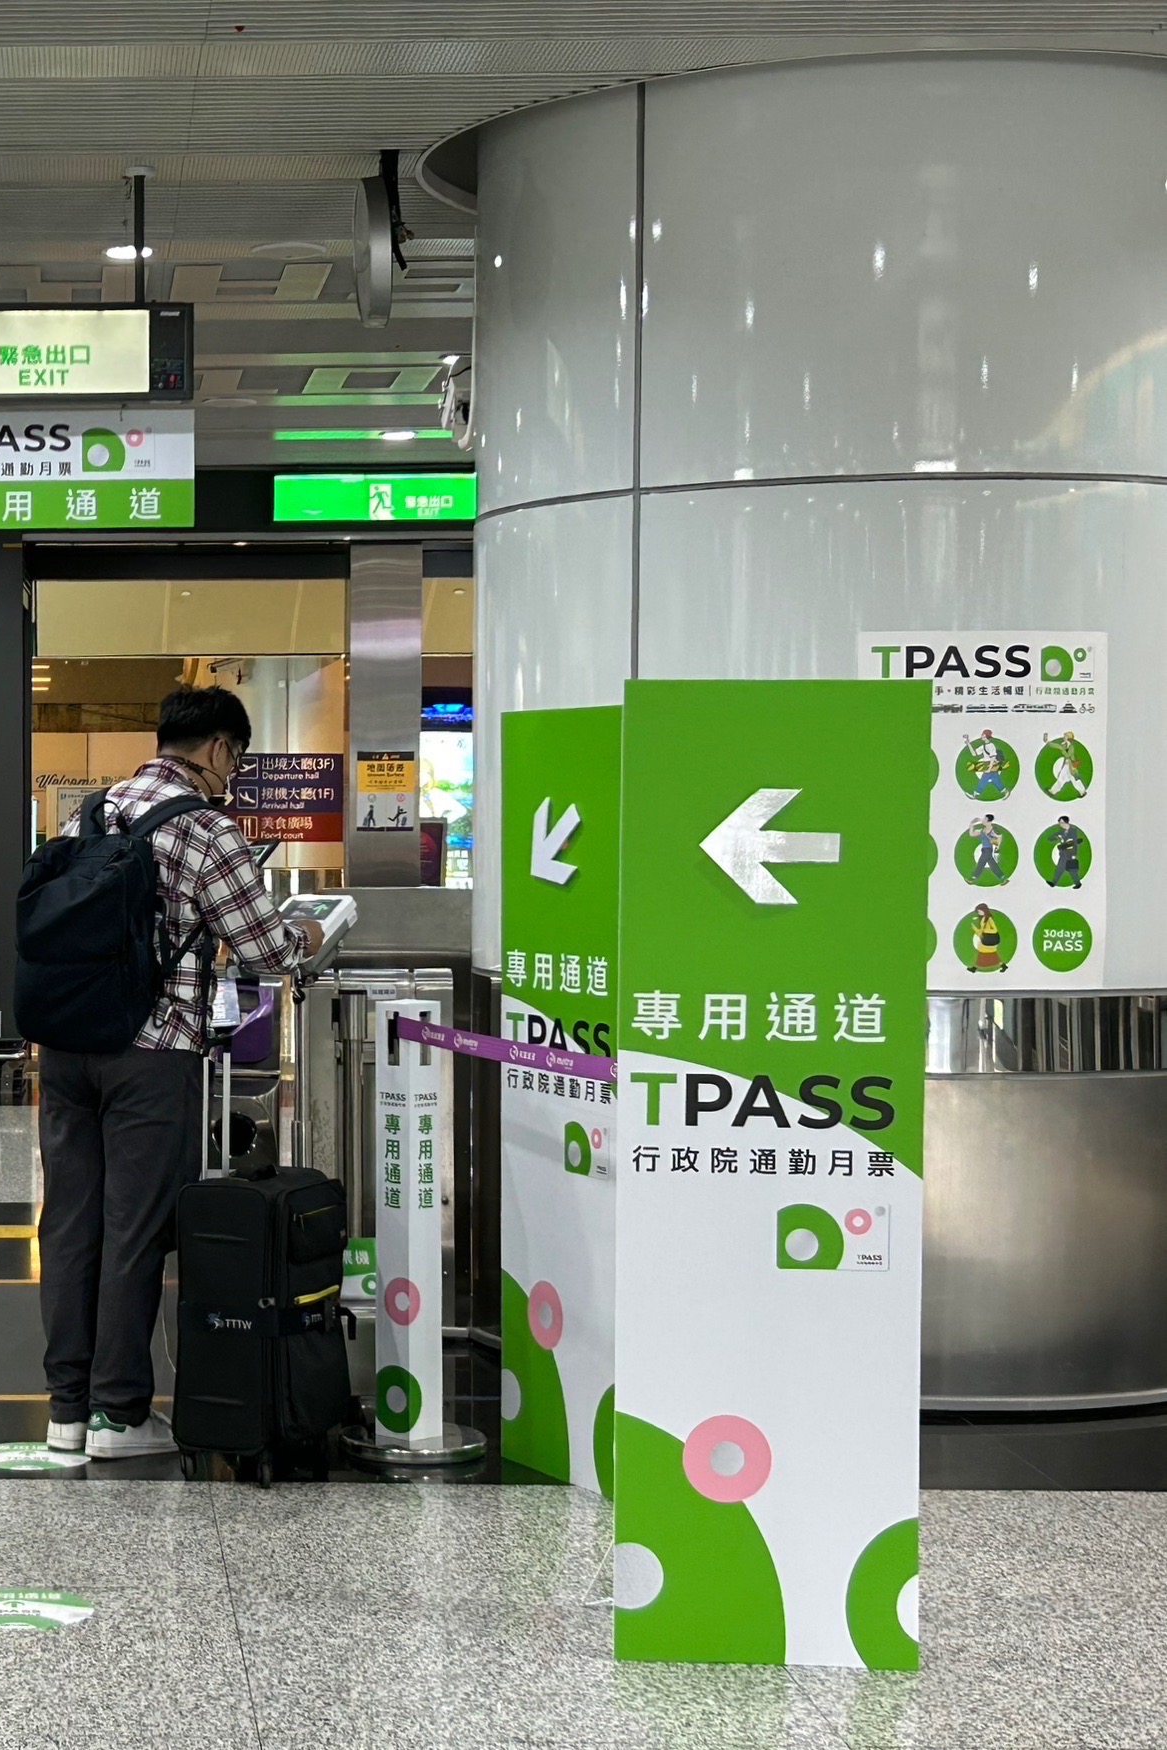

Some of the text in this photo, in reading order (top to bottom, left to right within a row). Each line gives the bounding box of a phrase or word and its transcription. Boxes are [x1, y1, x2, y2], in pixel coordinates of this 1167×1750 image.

[18, 368, 69, 386] EXIT
[871, 645, 1032, 678] TPASS
[261, 757, 335, 771] 出境大廳(3F)
[262, 772, 320, 781] Departure hall
[1043, 929, 1083, 940] 30days
[1043, 940, 1083, 952] PASS
[506, 949, 608, 996] 專用通道
[631, 990, 886, 1042] 專用通道
[379, 1092, 407, 1101] TPASS
[414, 1092, 438, 1101] TPASS
[630, 1072, 895, 1131] TPASS
[385, 1114, 401, 1209] 專用通道
[418, 1114, 434, 1209] 專用通道
[632, 1145, 895, 1177] 行政院通勤月票
[225, 1319, 252, 1330] TTTW
